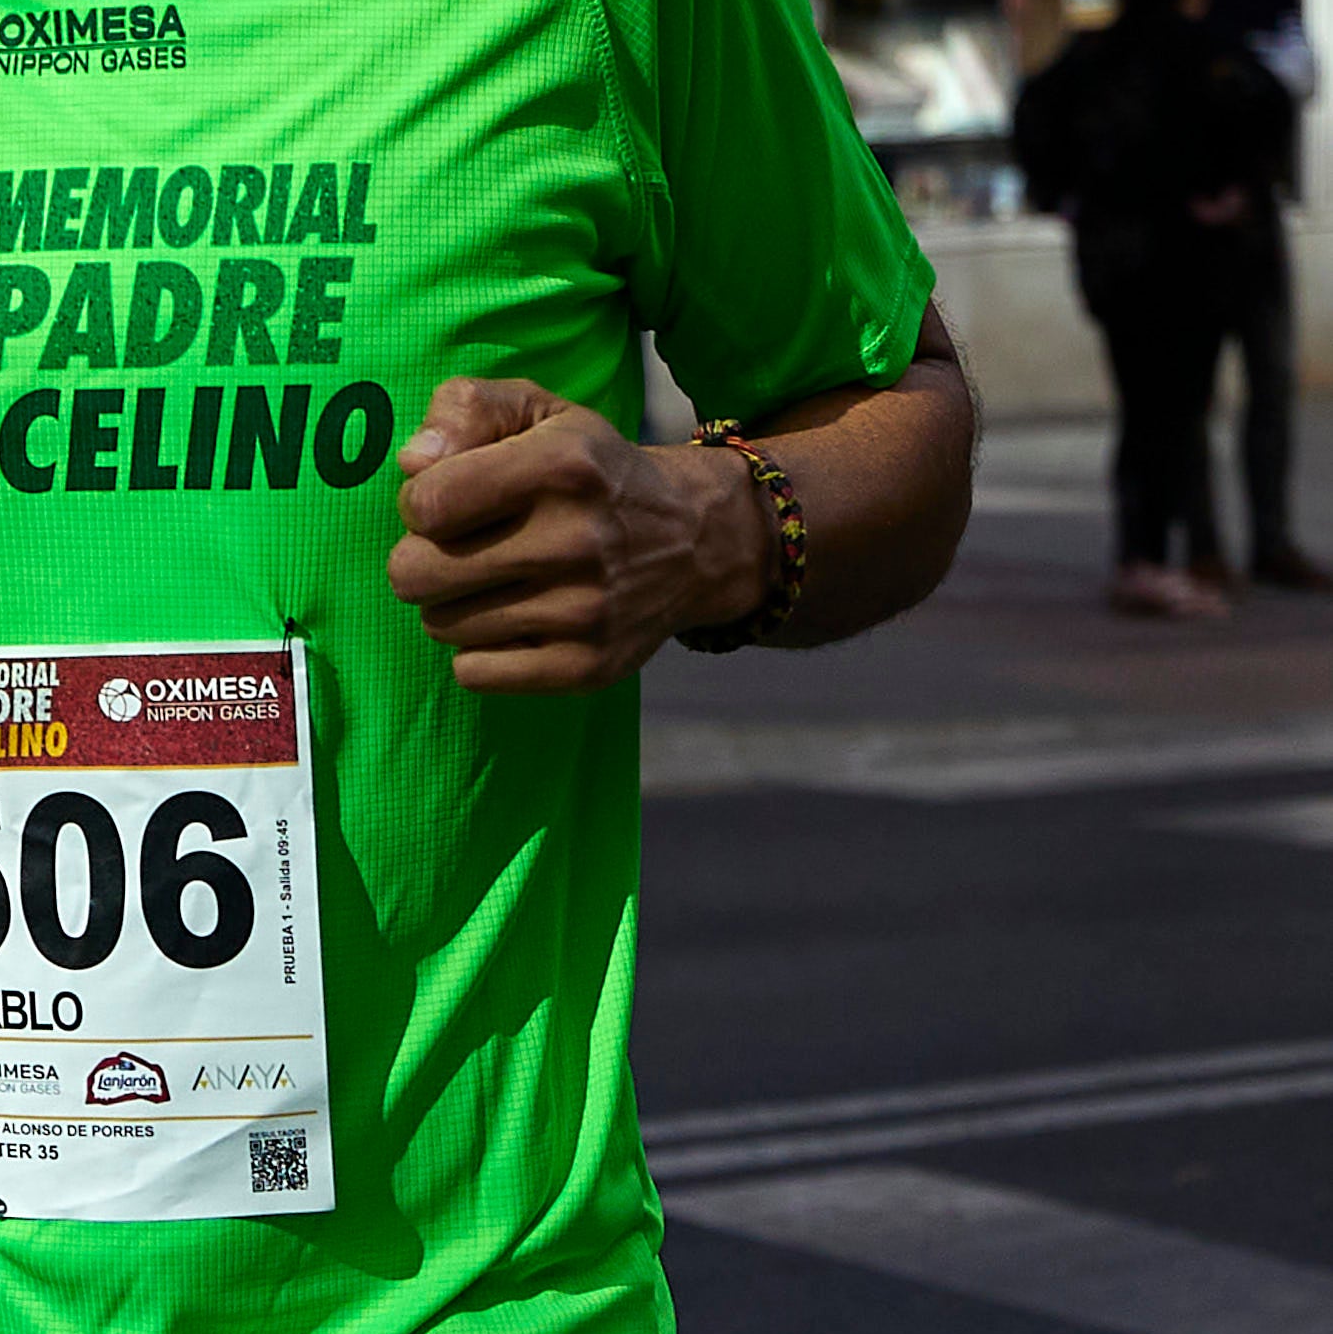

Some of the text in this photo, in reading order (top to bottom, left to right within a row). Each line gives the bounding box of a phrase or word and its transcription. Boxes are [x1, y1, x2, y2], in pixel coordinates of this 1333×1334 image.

[100, 45, 187, 73] GASES
[145, 675, 279, 702] OXIMESA
[146, 703, 280, 722] NIPPON GASES
[276, 819, 290, 856] 09:45
[279, 859, 292, 901] Salida
[282, 925, 296, 984] PRUEBA
[20, 1082, 62, 1095] GASES
[97, 1073, 157, 1091] Lanjarón
[192, 1063, 296, 1091] ANAYA
[2, 1122, 63, 1137] ALONSO
[67, 1124, 87, 1137] DE
[91, 1125, 155, 1138] PORRES
[37, 1144, 59, 1160] 35
